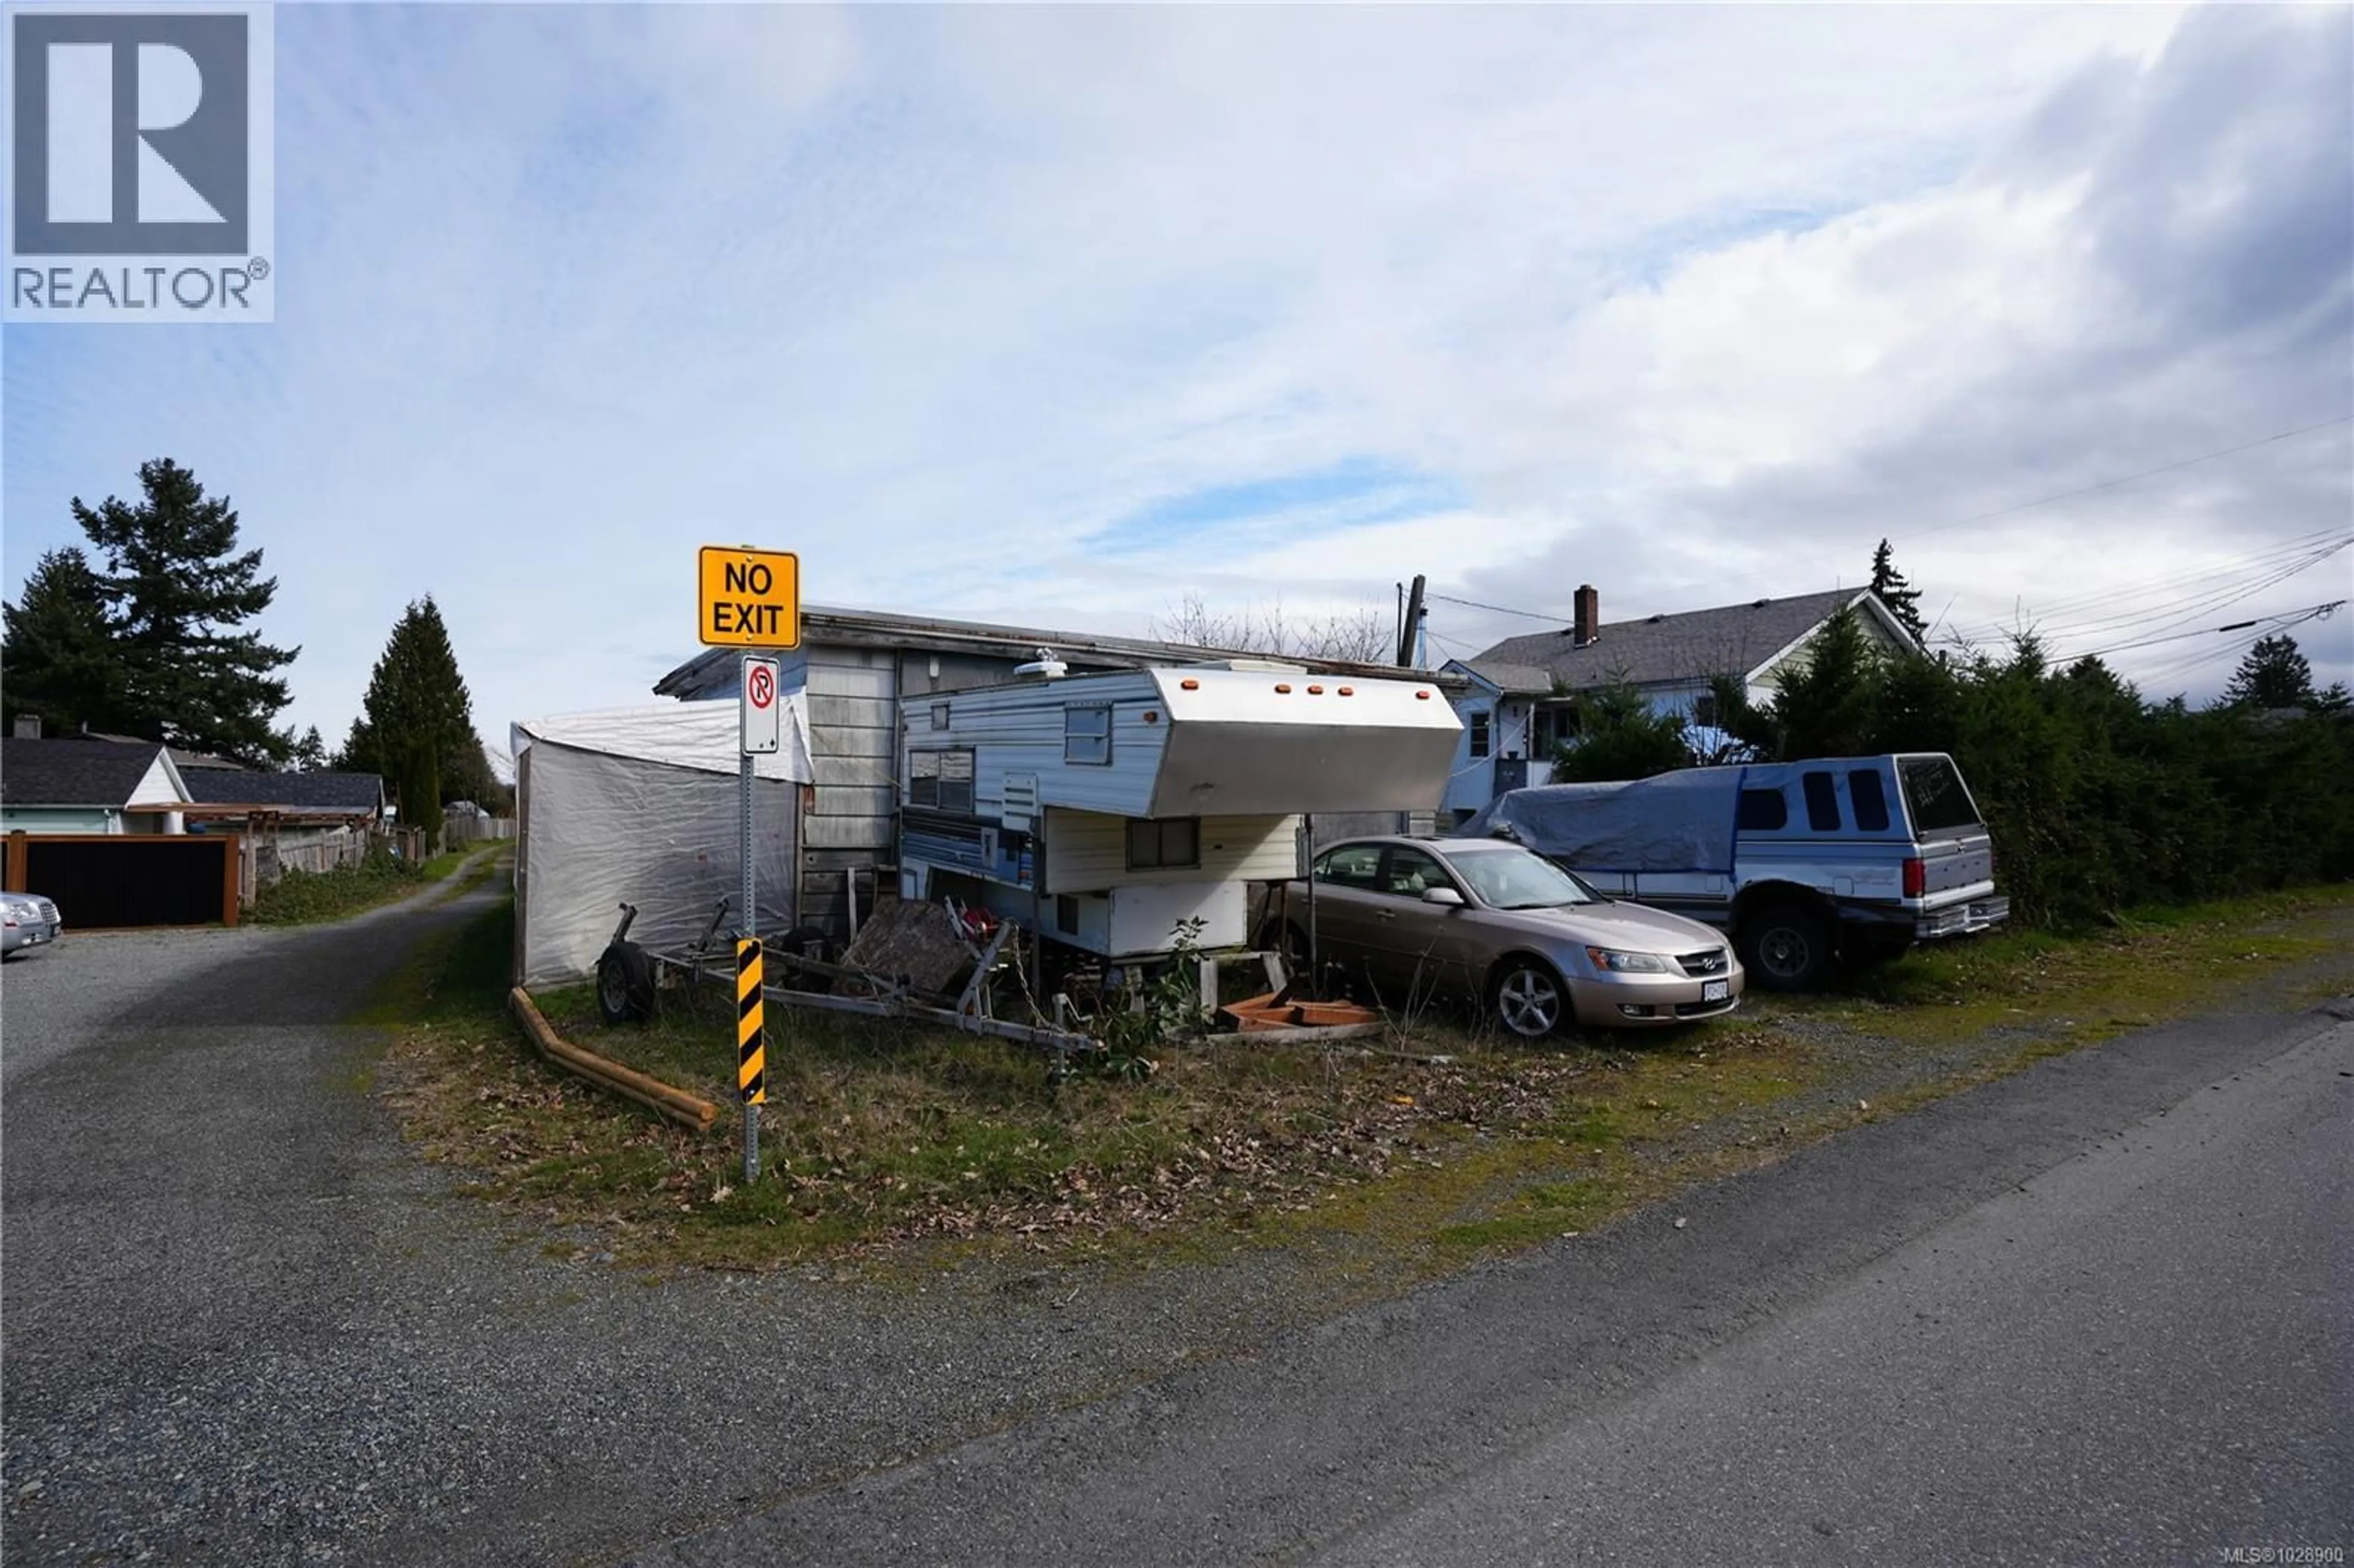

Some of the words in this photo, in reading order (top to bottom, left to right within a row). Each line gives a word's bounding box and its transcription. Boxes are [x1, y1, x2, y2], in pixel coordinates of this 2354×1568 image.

[725, 562, 772, 595] NO
[714, 602, 783, 634] EXIT
[757, 674, 769, 699] P
